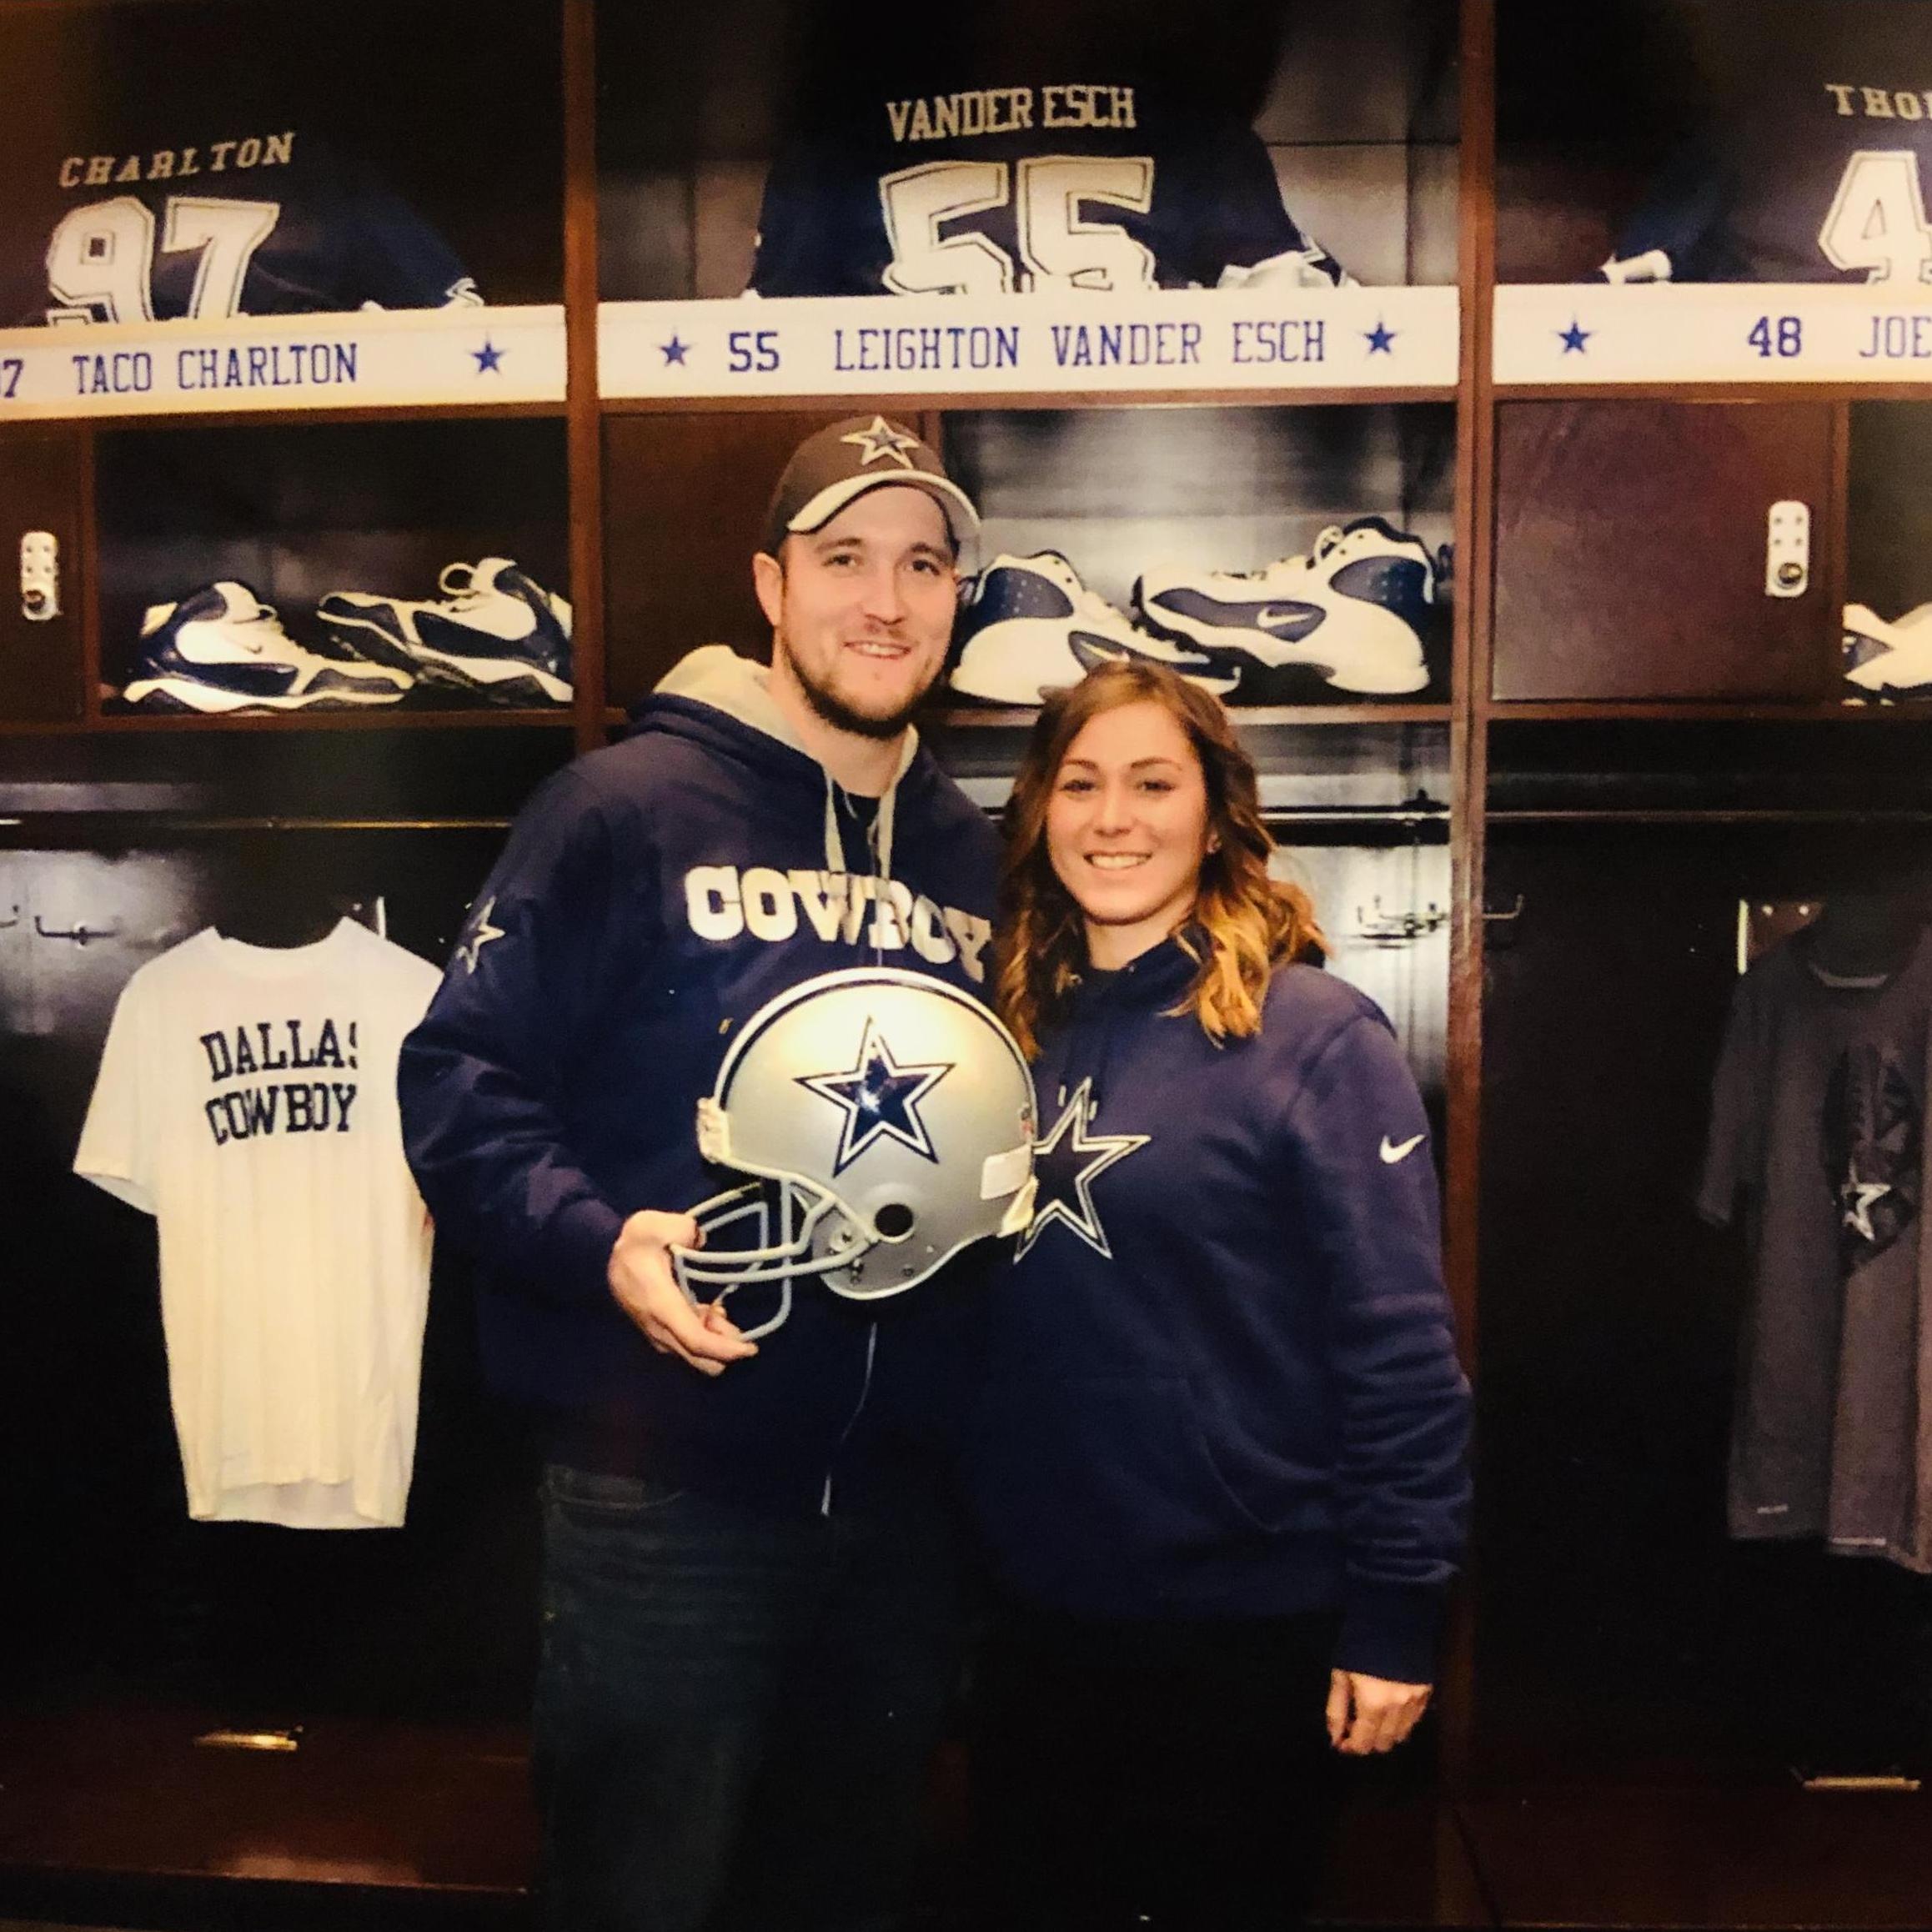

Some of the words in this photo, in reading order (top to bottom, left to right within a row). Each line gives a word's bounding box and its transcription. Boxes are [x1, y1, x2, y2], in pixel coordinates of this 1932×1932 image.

[886, 88, 1033, 142] VANDER
[1042, 84, 1137, 128] ESCH
[59, 131, 296, 188] CHARLTON
[878, 155, 1155, 294] 55
[46, 195, 280, 325] 97
[729, 331, 780, 372] 55
[835, 326, 1020, 370] LEIGHTON
[1051, 323, 1202, 367] VANDER
[1232, 320, 1326, 364] ESCH
[1748, 316, 1802, 357] 48
[1859, 316, 1932, 357] JOE
[73, 353, 153, 394] TACO
[178, 343, 358, 389] CHARLTON
[204, 1082, 357, 1147] COWBOY
